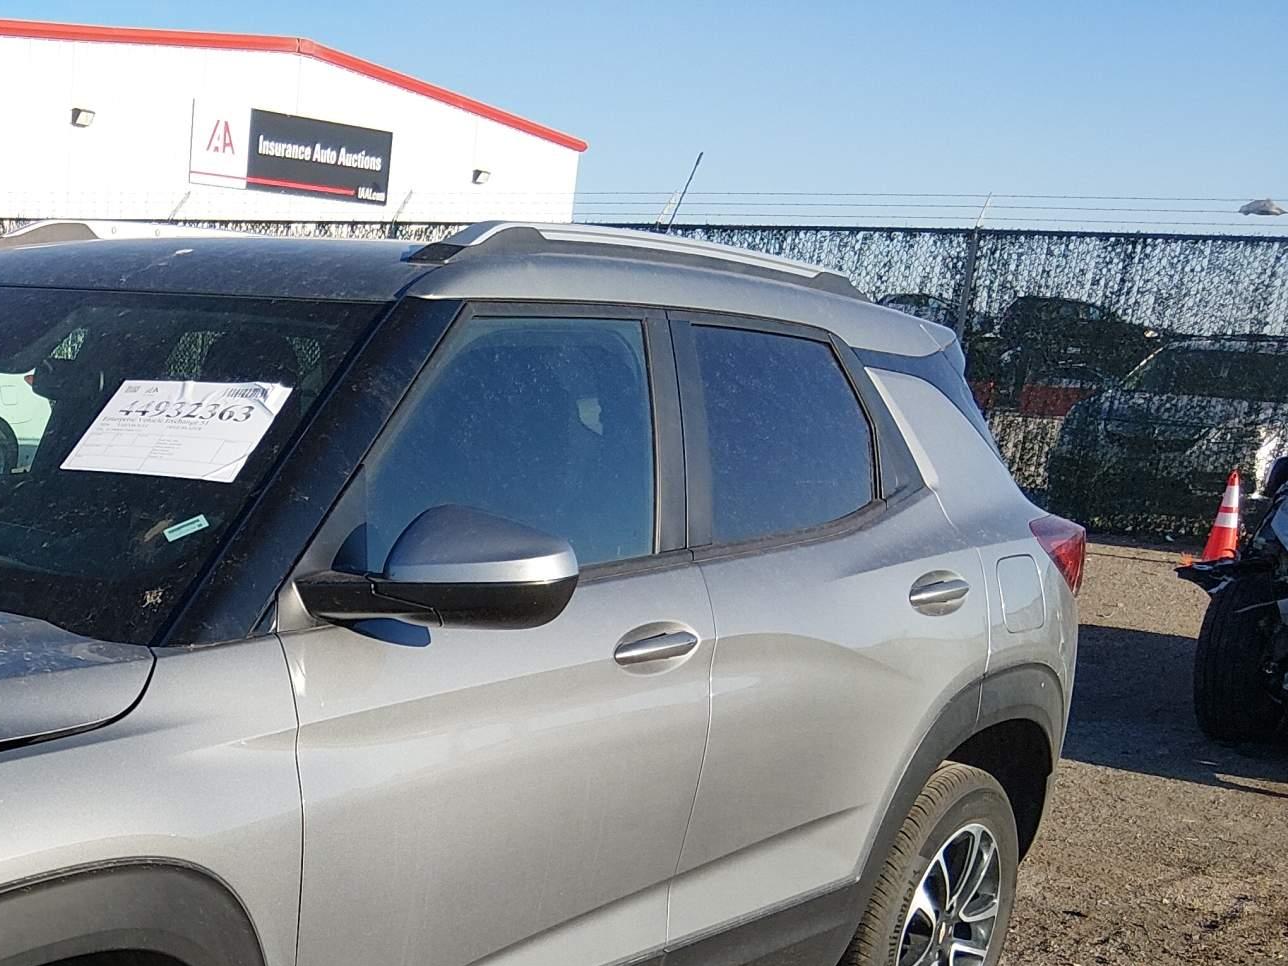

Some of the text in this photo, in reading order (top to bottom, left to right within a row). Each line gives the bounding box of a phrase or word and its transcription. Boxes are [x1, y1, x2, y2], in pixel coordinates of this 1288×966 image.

[258, 134, 382, 171] Insurance Auto Auctions
[120, 400, 255, 422] 44932363
